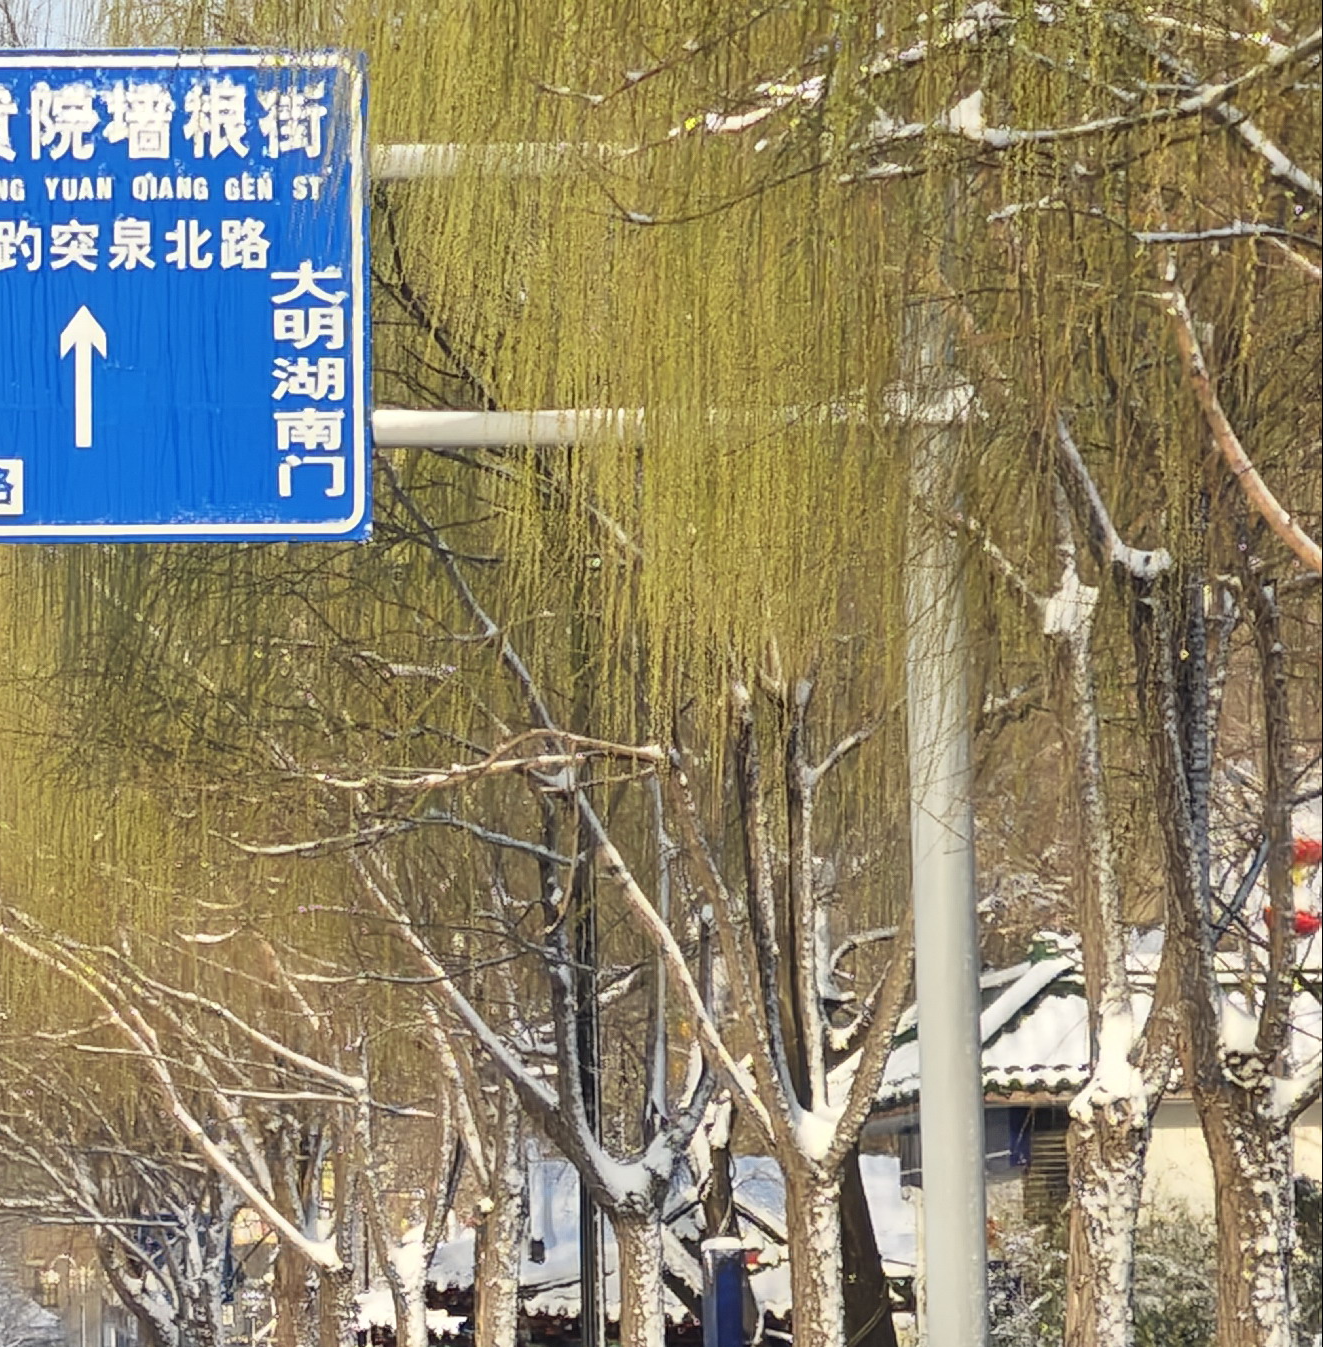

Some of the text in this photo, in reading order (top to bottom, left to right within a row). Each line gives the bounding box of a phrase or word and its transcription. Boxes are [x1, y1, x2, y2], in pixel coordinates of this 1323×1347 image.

[45, 177, 113, 202] YUAN
[132, 174, 209, 202] QIANG
[224, 174, 273, 202] GEN
[292, 176, 324, 201] ST
[270, 261, 345, 498] 大明湖南门
